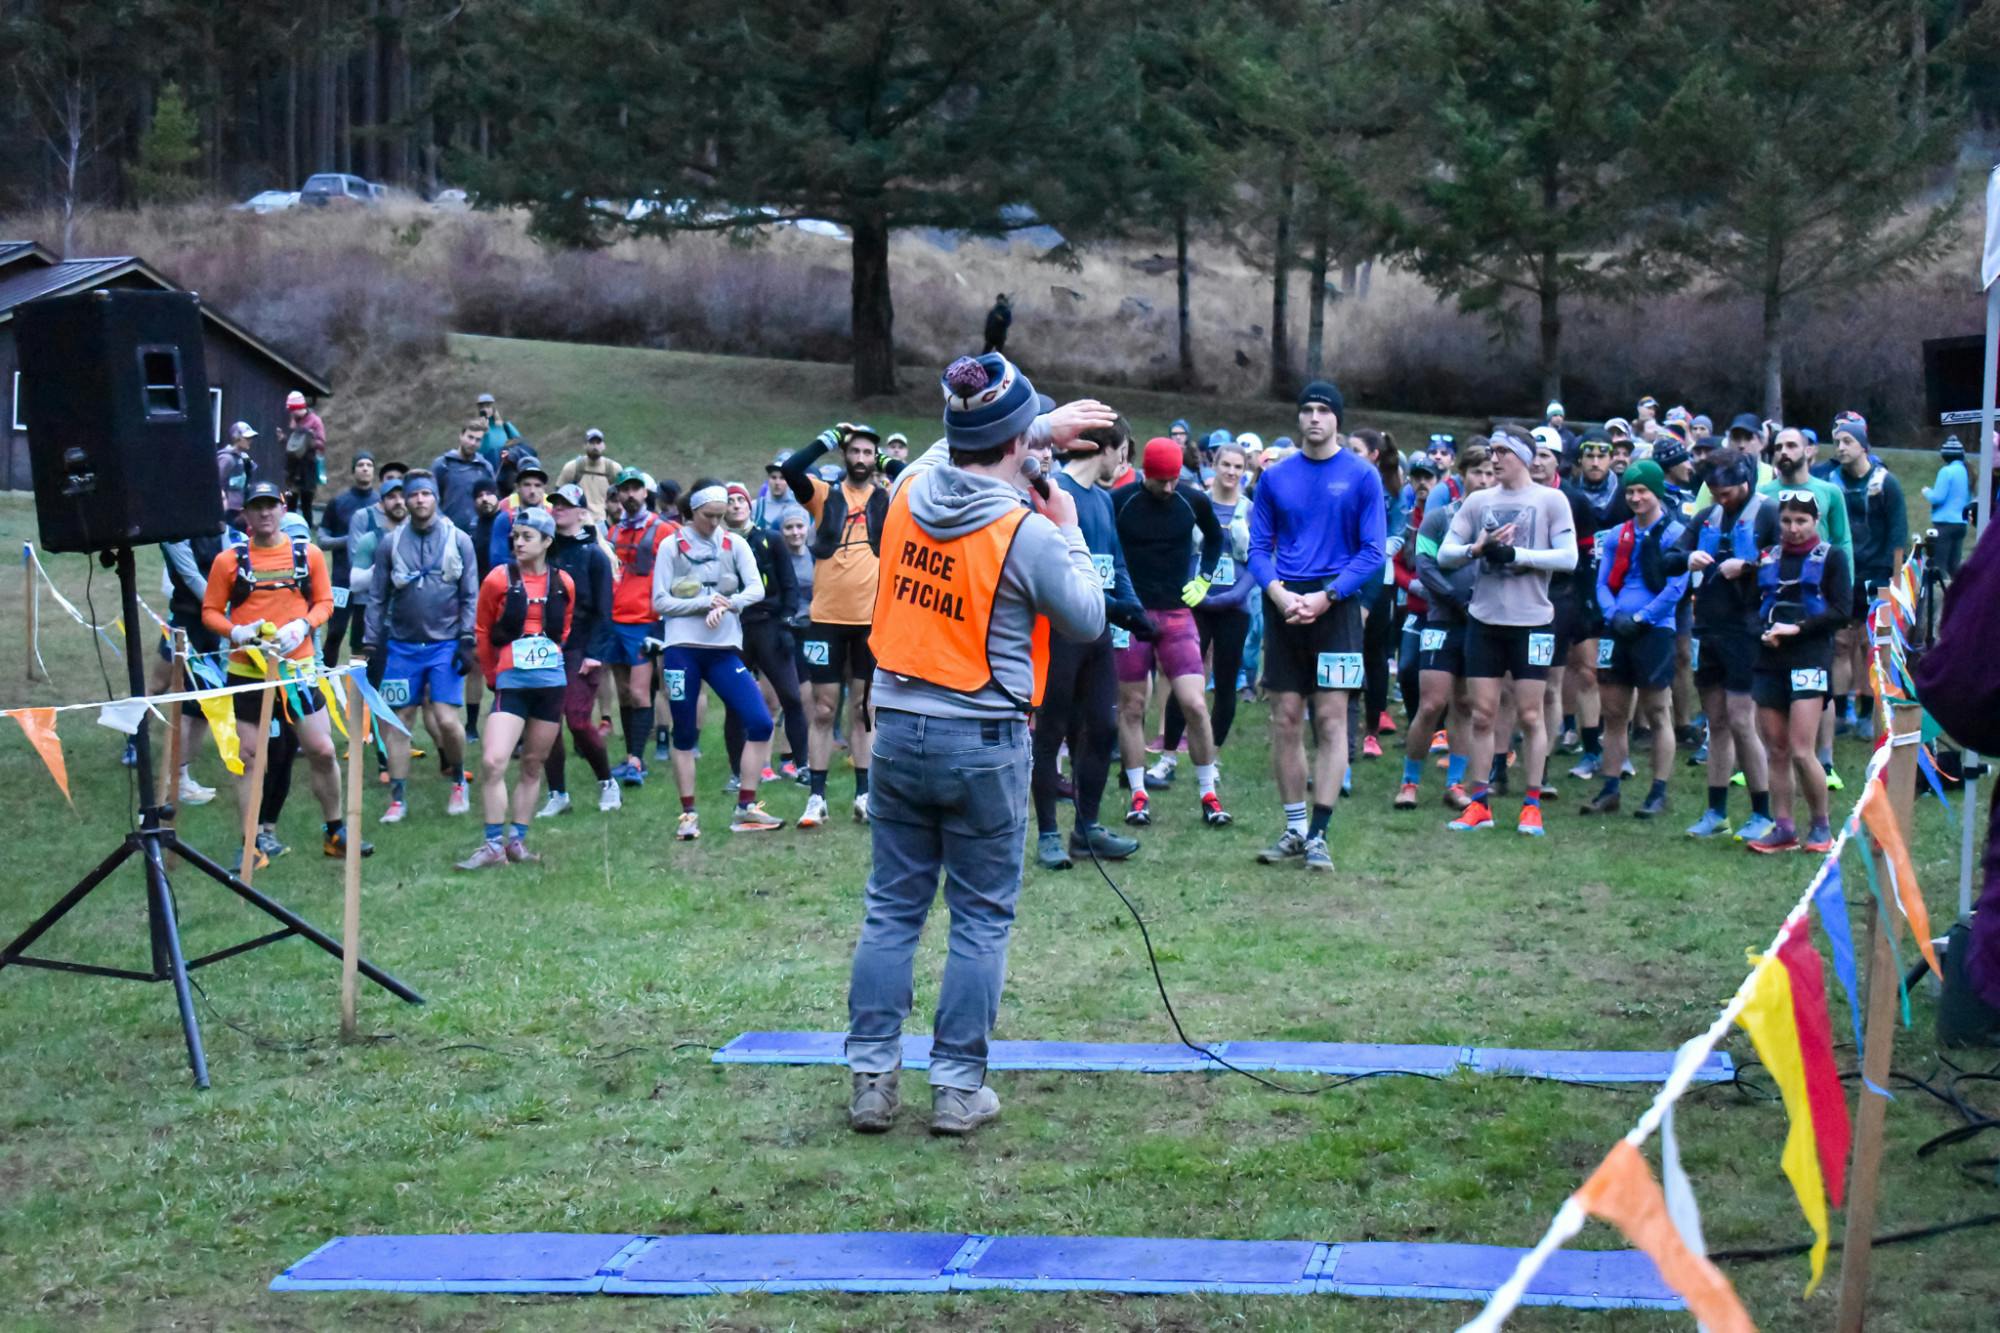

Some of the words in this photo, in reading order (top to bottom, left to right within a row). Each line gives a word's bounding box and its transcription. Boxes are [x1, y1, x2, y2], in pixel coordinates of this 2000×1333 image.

[901, 540, 955, 582] RACE
[894, 574, 965, 622] FFICIAL
[525, 647, 549, 665] 49
[807, 645, 825, 662] 72
[1324, 665, 1361, 684] 117
[1795, 668, 1823, 688] 54
